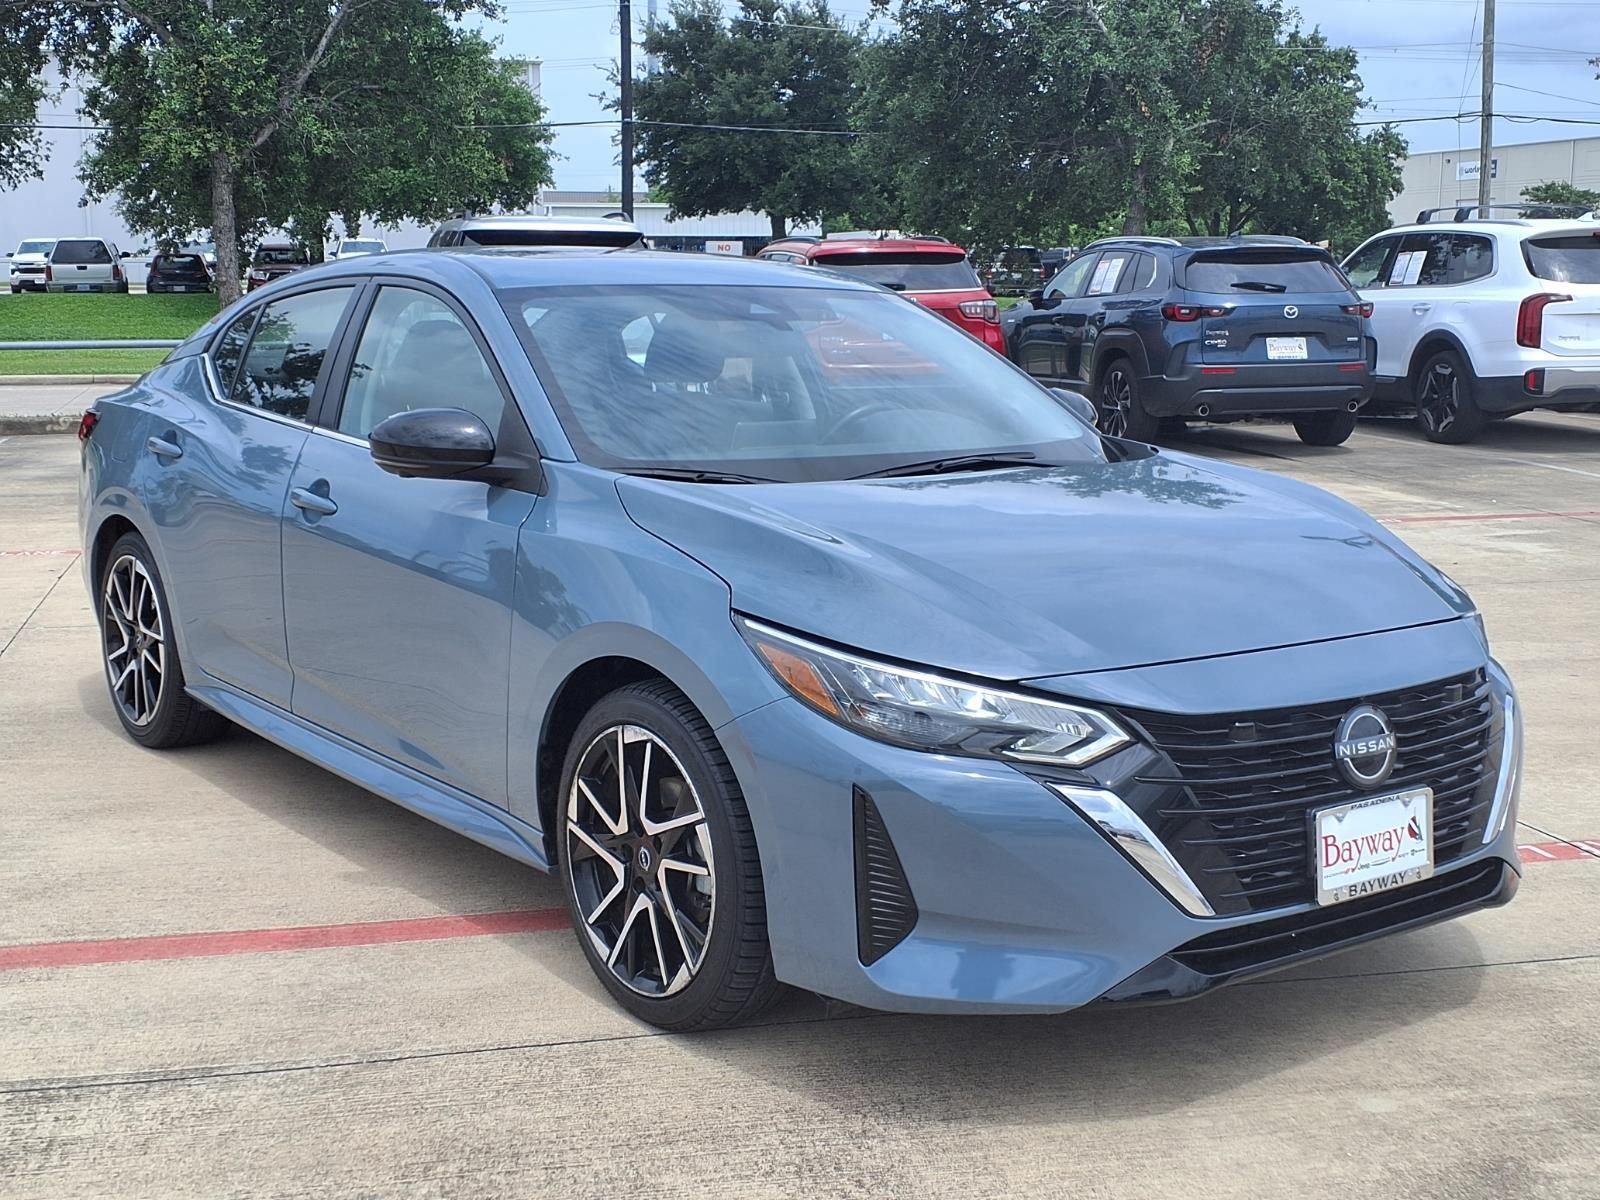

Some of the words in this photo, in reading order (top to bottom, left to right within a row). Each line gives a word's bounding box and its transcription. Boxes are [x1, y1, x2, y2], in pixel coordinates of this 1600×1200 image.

[1339, 735, 1395, 757] NISSAN
[1350, 795, 1400, 811] PASADENA
[1322, 827, 1405, 872] Bayway
[1349, 871, 1407, 897] BAYWAY
